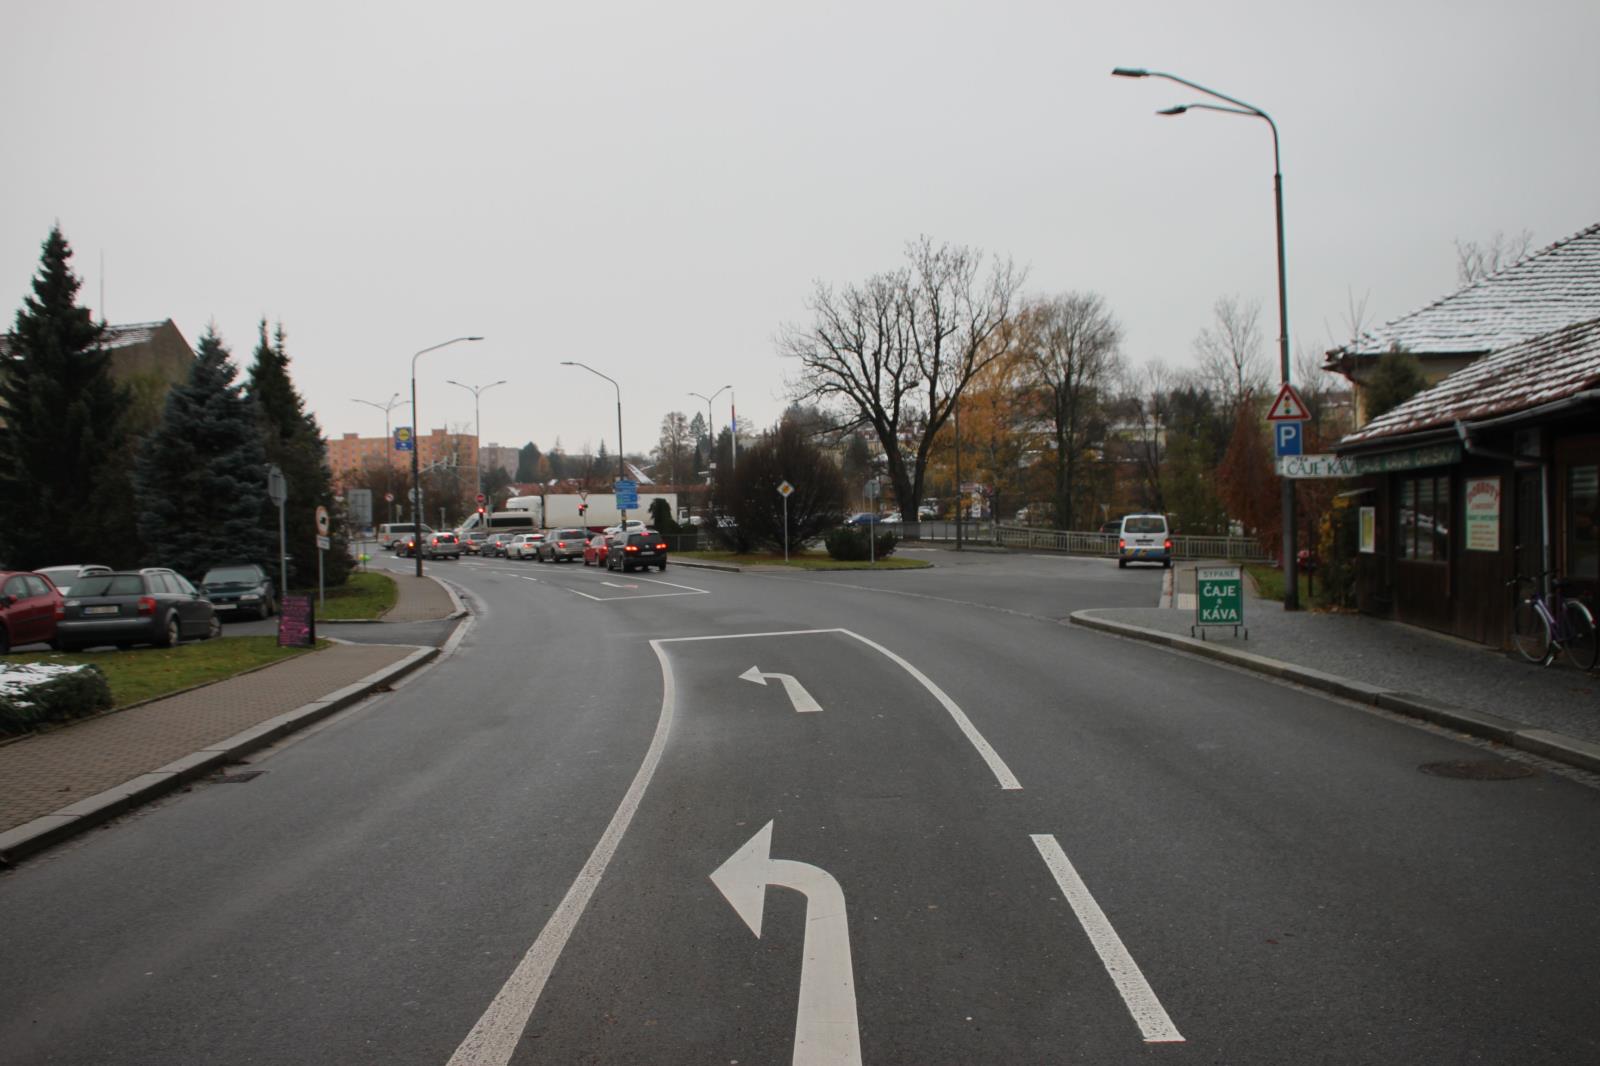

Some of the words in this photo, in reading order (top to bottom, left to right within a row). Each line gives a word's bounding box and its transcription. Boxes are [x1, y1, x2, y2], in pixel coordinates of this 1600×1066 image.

[1279, 426, 1297, 447] P
[1203, 581, 1236, 597] ČAJE
[1202, 604, 1238, 620] KÁVA
